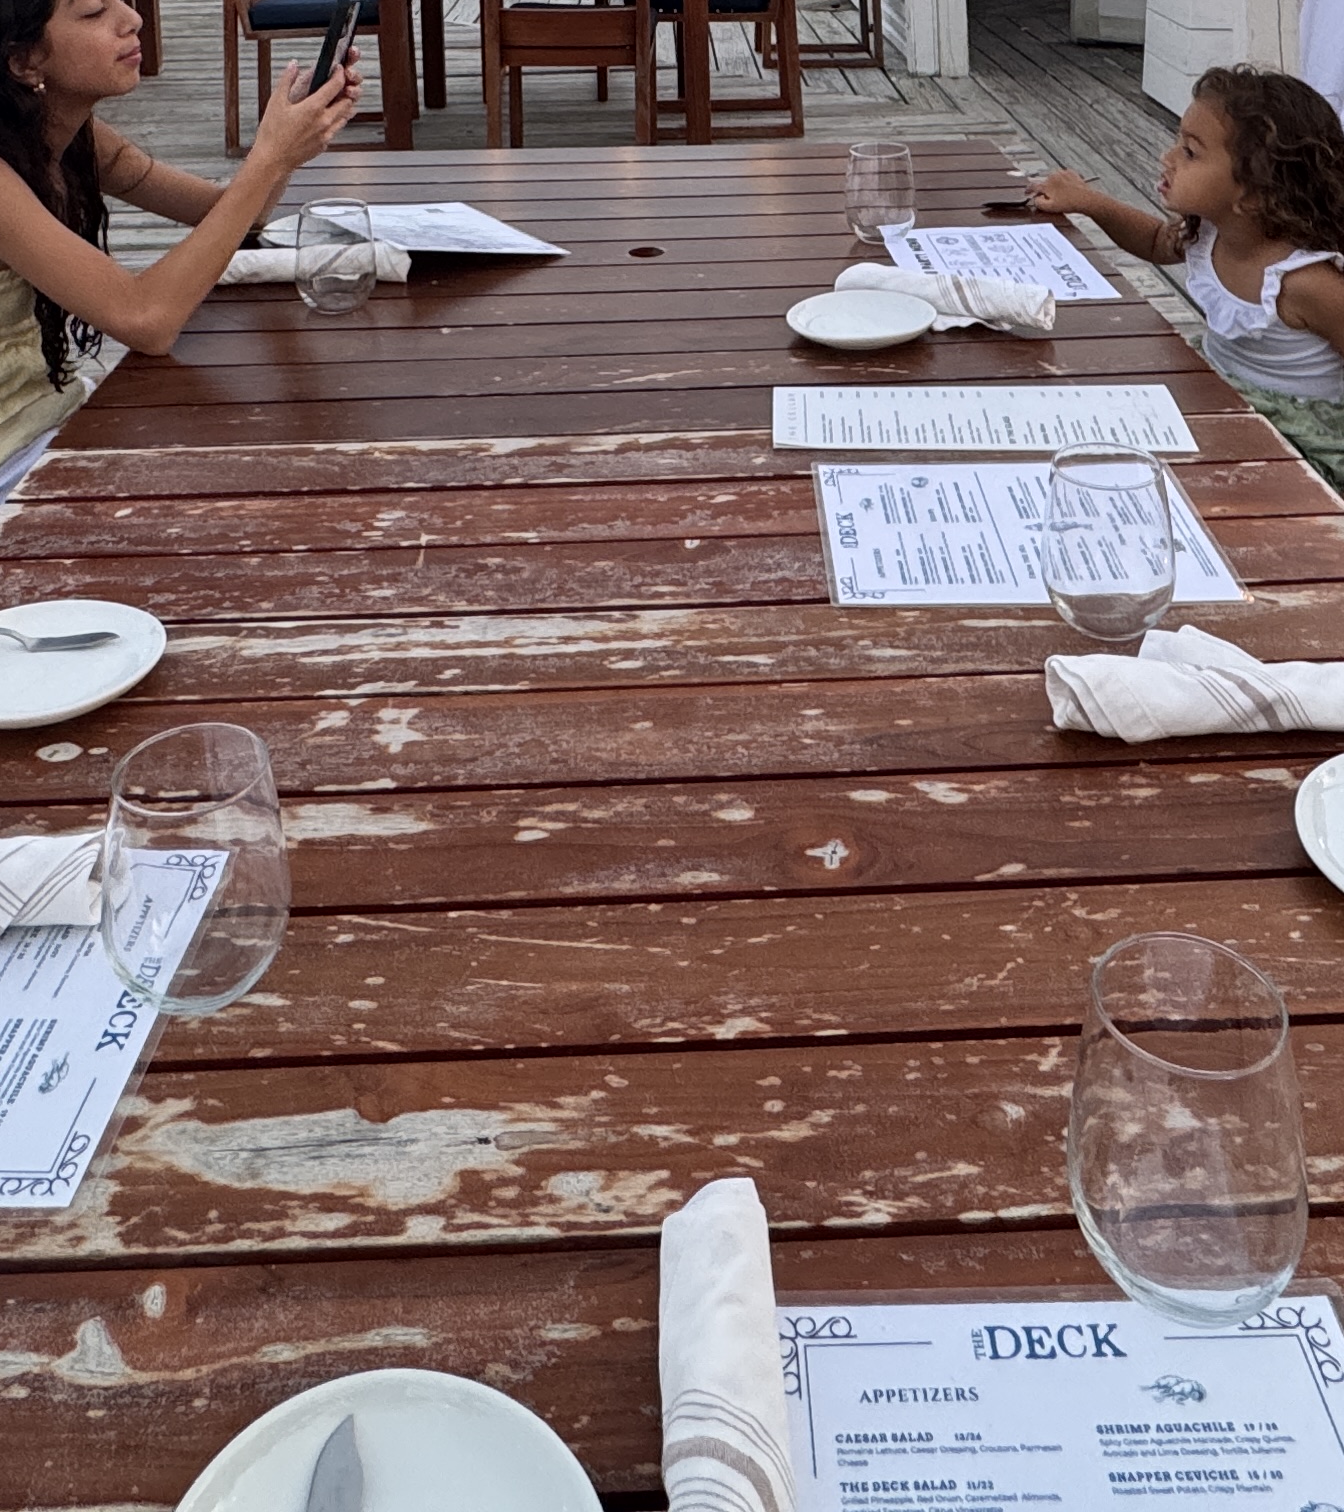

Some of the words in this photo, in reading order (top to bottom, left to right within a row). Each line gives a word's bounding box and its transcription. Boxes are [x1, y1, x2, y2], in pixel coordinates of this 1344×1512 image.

[836, 512, 858, 545] DECK
[971, 1328, 986, 1360] THE
[984, 1323, 1127, 1360] DECK
[859, 1387, 979, 1403] APPETIZERS
[1096, 1423, 1151, 1434] SHRIMP
[1156, 1421, 1236, 1433] AGUACHILE
[835, 1433, 888, 1444] CAESAR
[892, 1432, 934, 1443] SALAD
[1108, 1471, 1173, 1483] SNAPPER
[1175, 1469, 1240, 1481] CEVICHE
[839, 1481, 870, 1493] THE
[872, 1480, 911, 1492] DECK
[913, 1479, 957, 1491] SALAD
